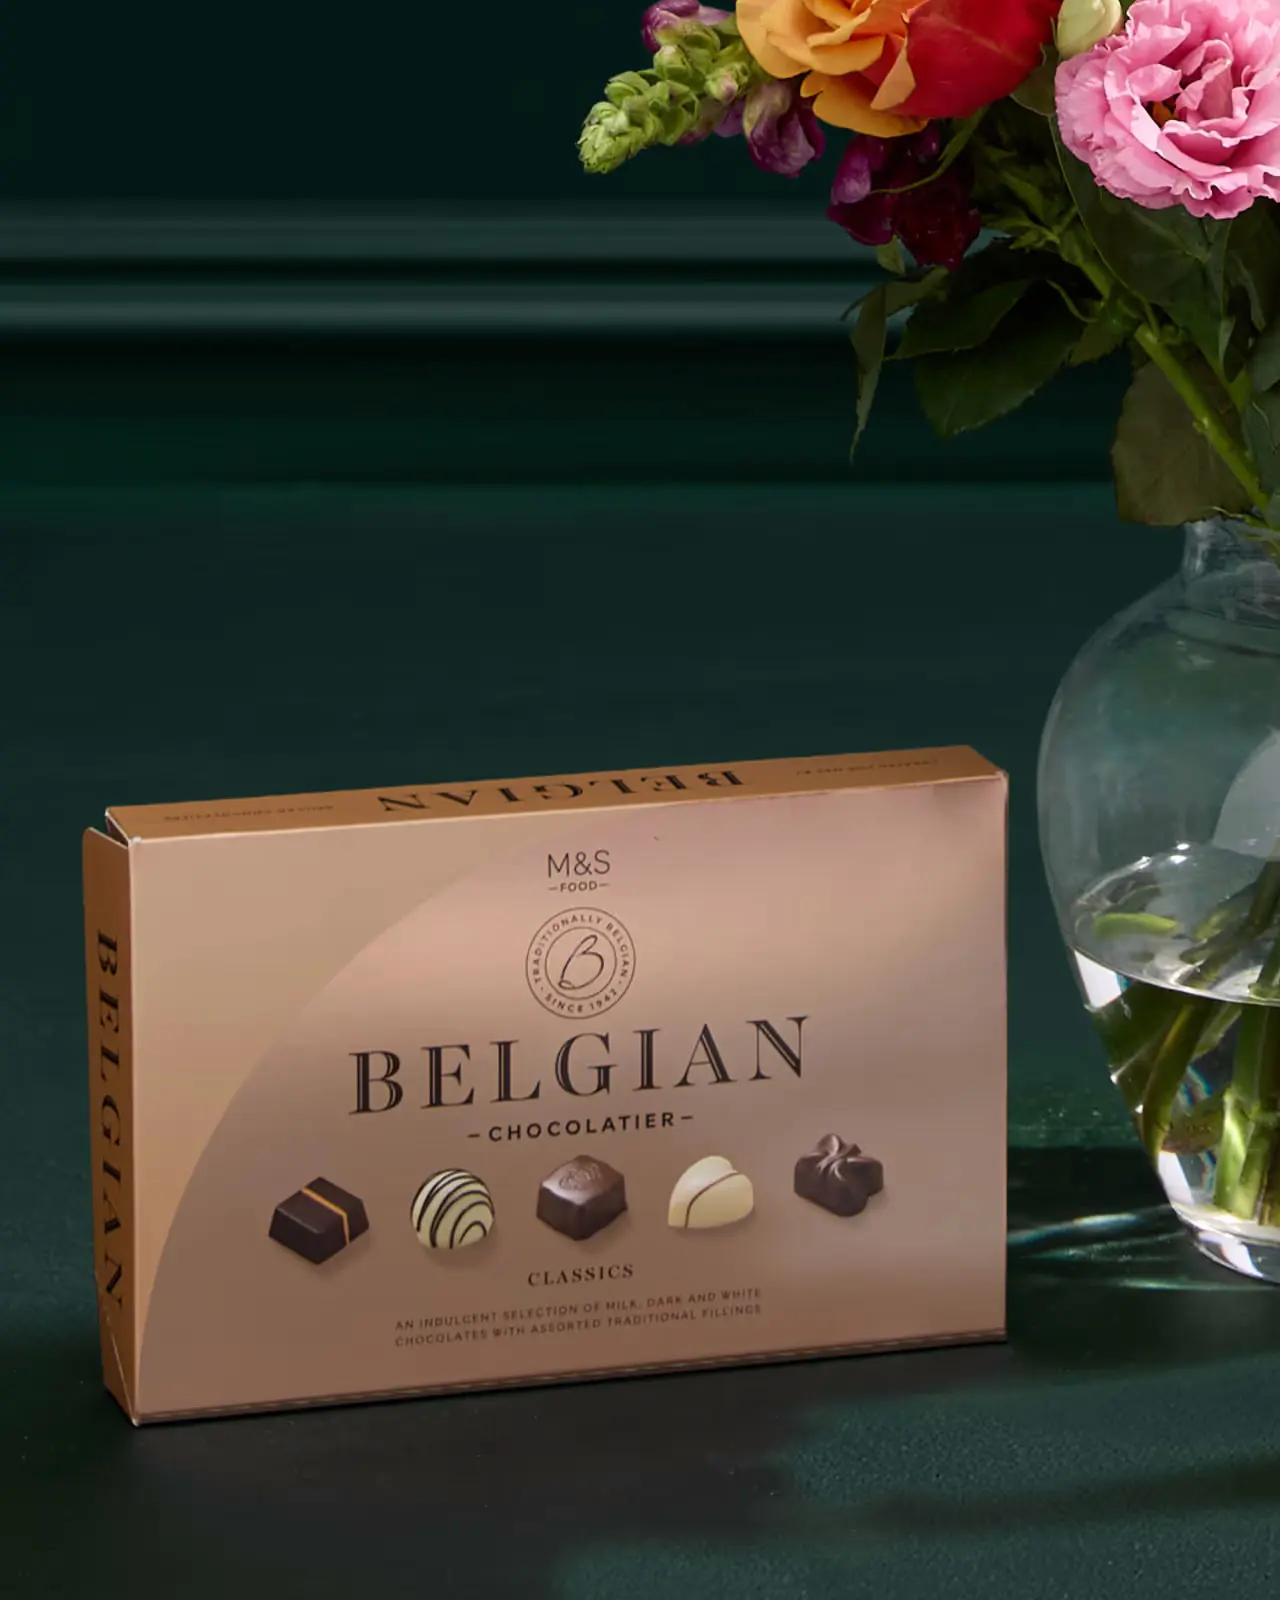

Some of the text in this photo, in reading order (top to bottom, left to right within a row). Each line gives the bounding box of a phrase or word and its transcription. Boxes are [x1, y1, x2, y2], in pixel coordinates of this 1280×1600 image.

[377, 770, 746, 812] BELGIAN
[547, 849, 611, 878] M&S
[559, 881, 598, 893] FOOD
[532, 914, 630, 984] TRADITIONALLY BELGIAN
[545, 993, 584, 1013] SINCE
[349, 1015, 809, 1115] BELGIAN
[97, 929, 123, 1309] BELGIAN
[488, 1111, 676, 1142] CHOCOLATIER
[527, 1264, 635, 1287] CLASSICS
[395, 1319, 414, 1331] AN
[419, 1311, 498, 1328] INDULGENT
[502, 1304, 578, 1320] SELECTION
[583, 1301, 600, 1313] OF
[646, 1294, 683, 1308] DARK
[688, 1291, 716, 1304] AND
[720, 1287, 762, 1301] WHITE
[395, 1303, 762, 1348] CHOCOLATES WITH ASSORTED TRADITIONAL FILLINGS
